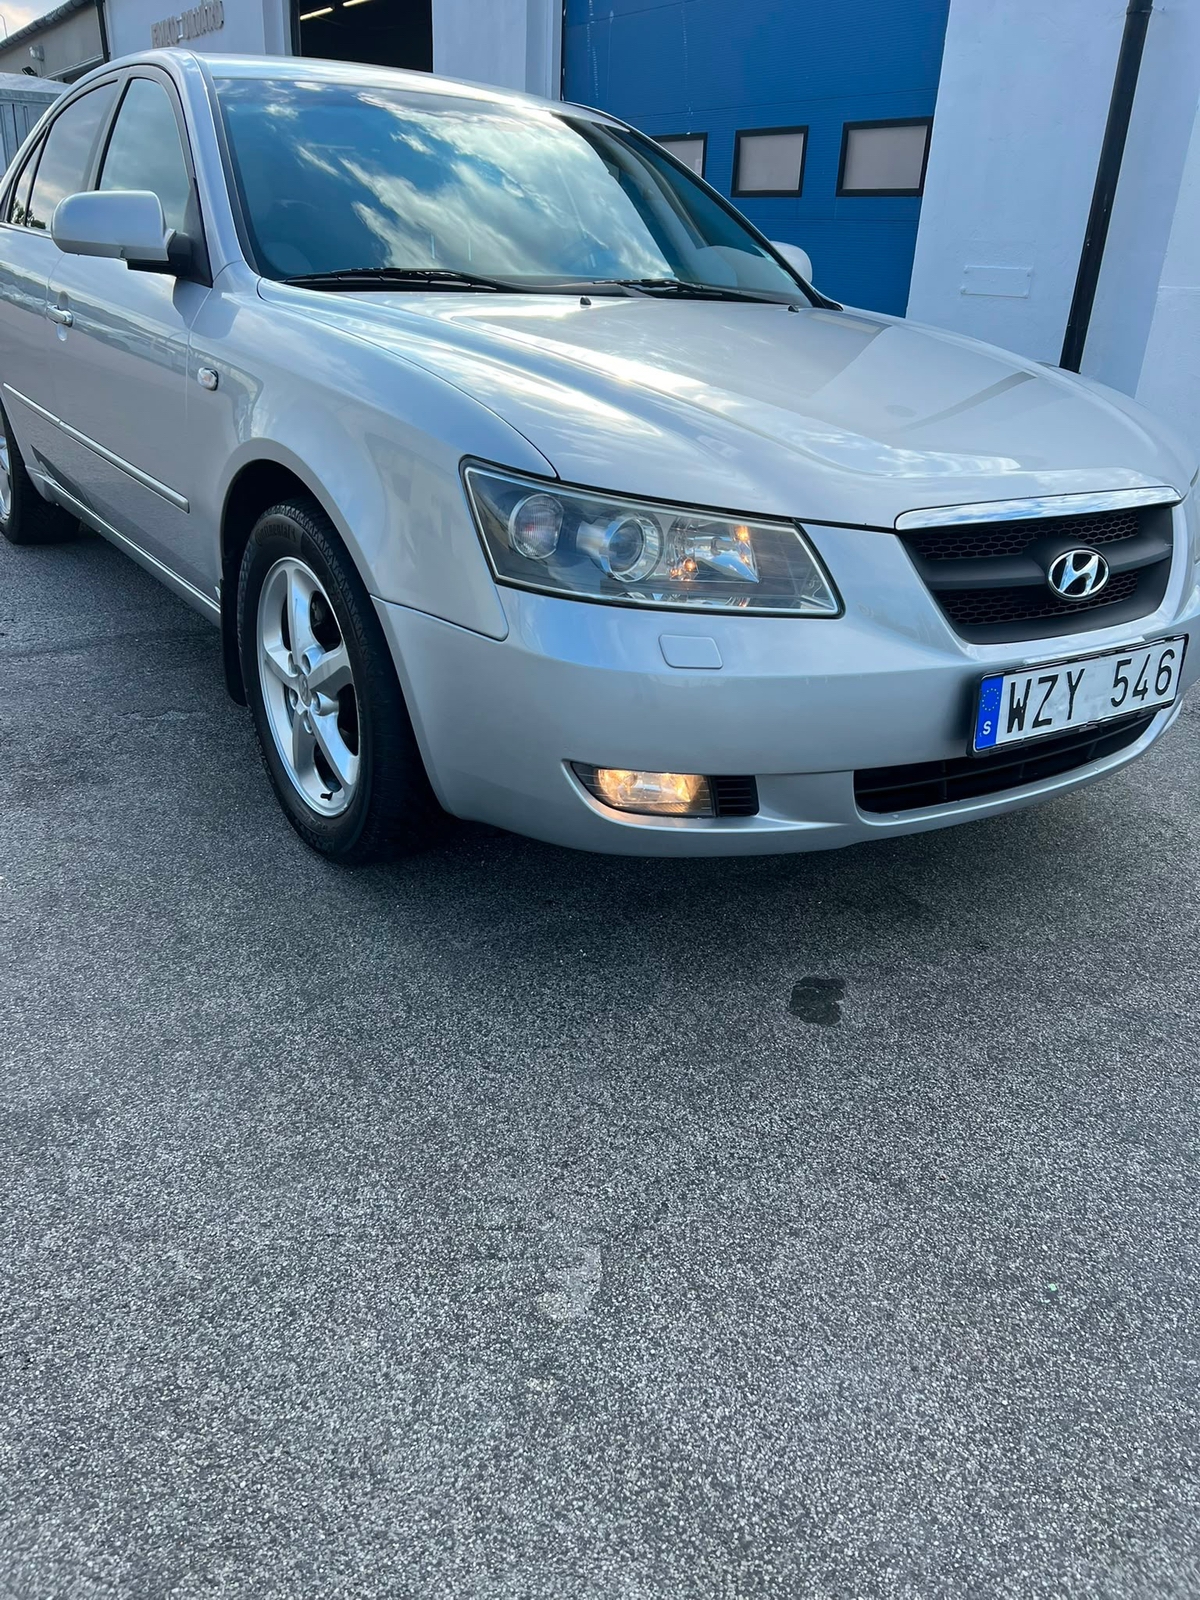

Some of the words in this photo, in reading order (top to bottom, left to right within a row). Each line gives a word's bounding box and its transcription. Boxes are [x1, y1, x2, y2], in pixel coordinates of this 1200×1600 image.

[1006, 668, 1086, 734] WZY
[1110, 649, 1175, 708] 546
[982, 720, 992, 735] S
